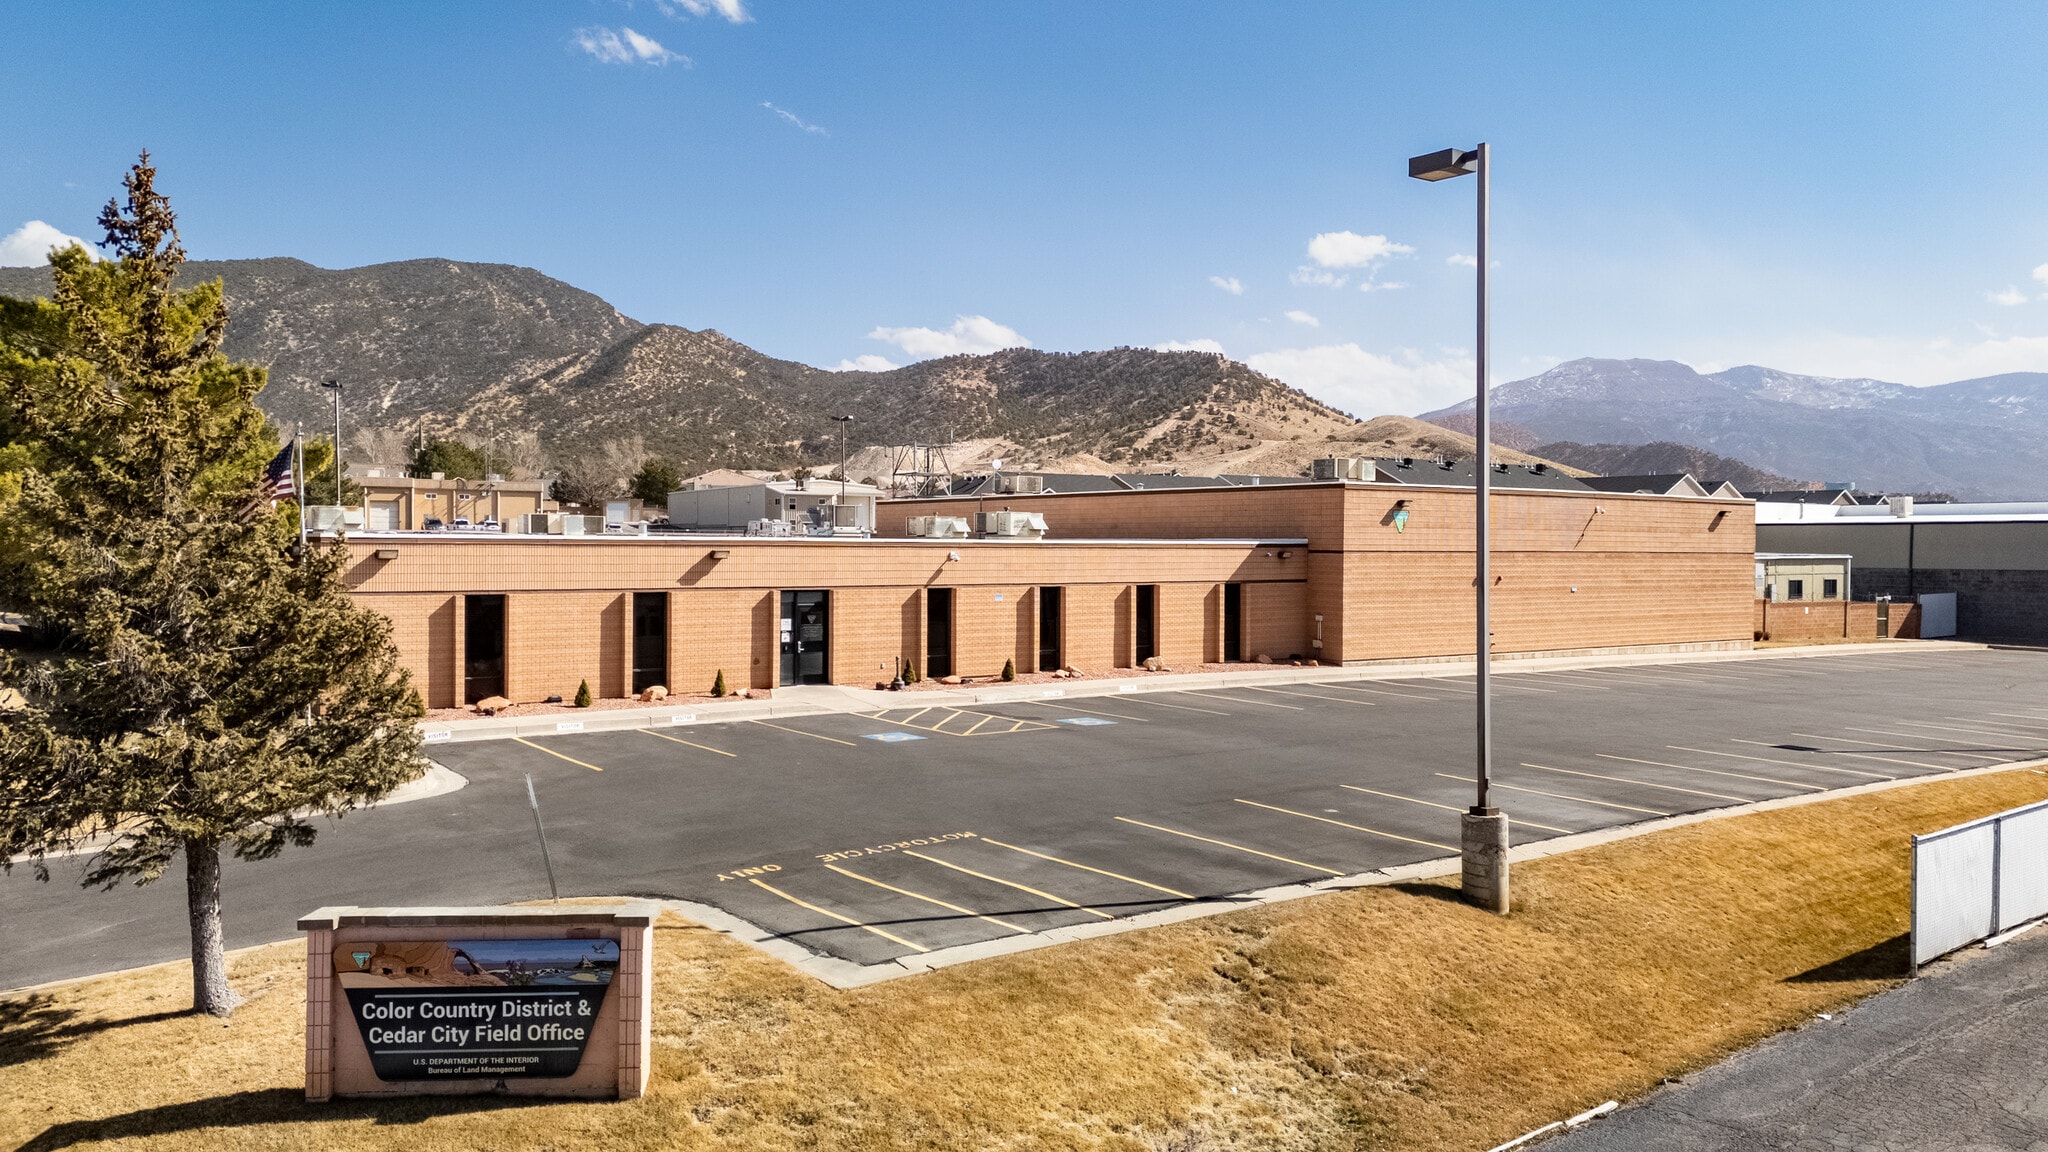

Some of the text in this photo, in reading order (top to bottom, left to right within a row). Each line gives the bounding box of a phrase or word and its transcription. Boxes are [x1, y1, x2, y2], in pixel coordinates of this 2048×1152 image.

[815, 831, 978, 862] MOTORCYCLE
[716, 864, 782, 882] ONLY
[362, 999, 591, 1021] Color Country District &
[369, 1023, 585, 1046] Cedar City Field Office
[429, 1058, 478, 1066] DEPARTMENT
[506, 1057, 539, 1065] INTERIOR
[481, 1066, 526, 1074] Management
